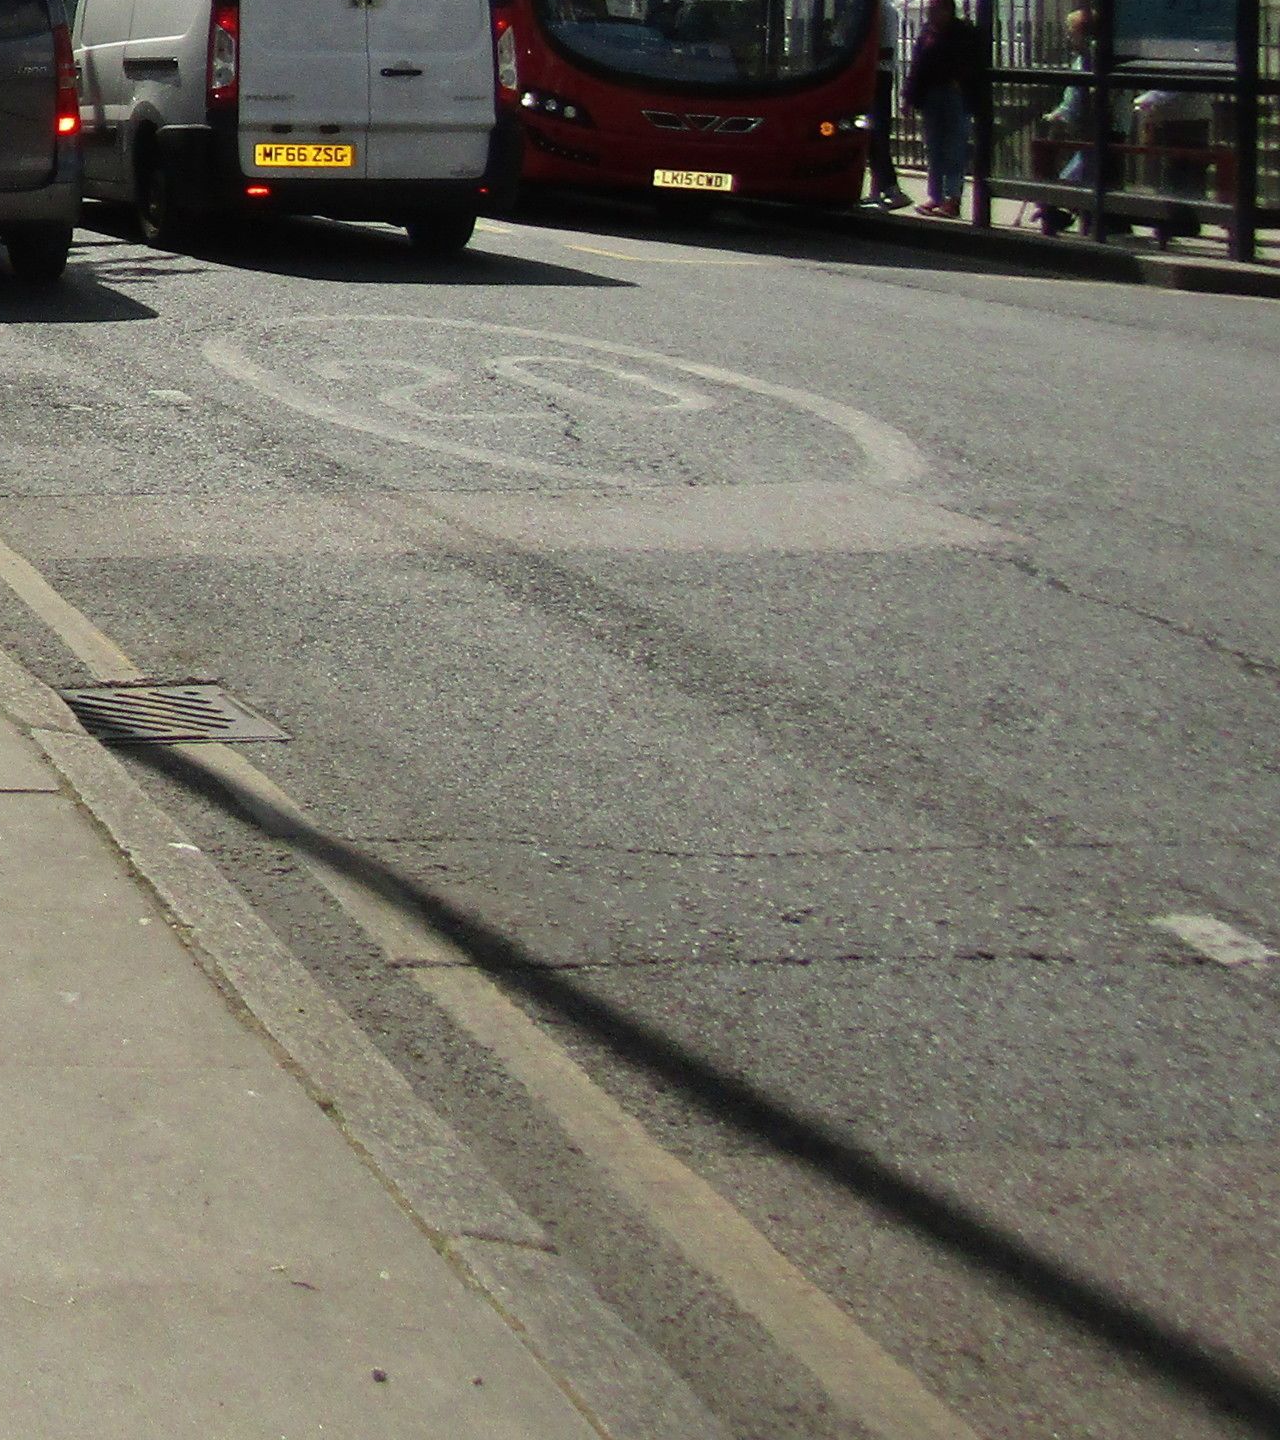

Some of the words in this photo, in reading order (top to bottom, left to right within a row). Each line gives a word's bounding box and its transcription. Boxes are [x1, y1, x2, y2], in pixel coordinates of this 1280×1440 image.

[262, 147, 307, 163] MF66
[312, 147, 346, 163] ZSG
[661, 171, 693, 186] LK15
